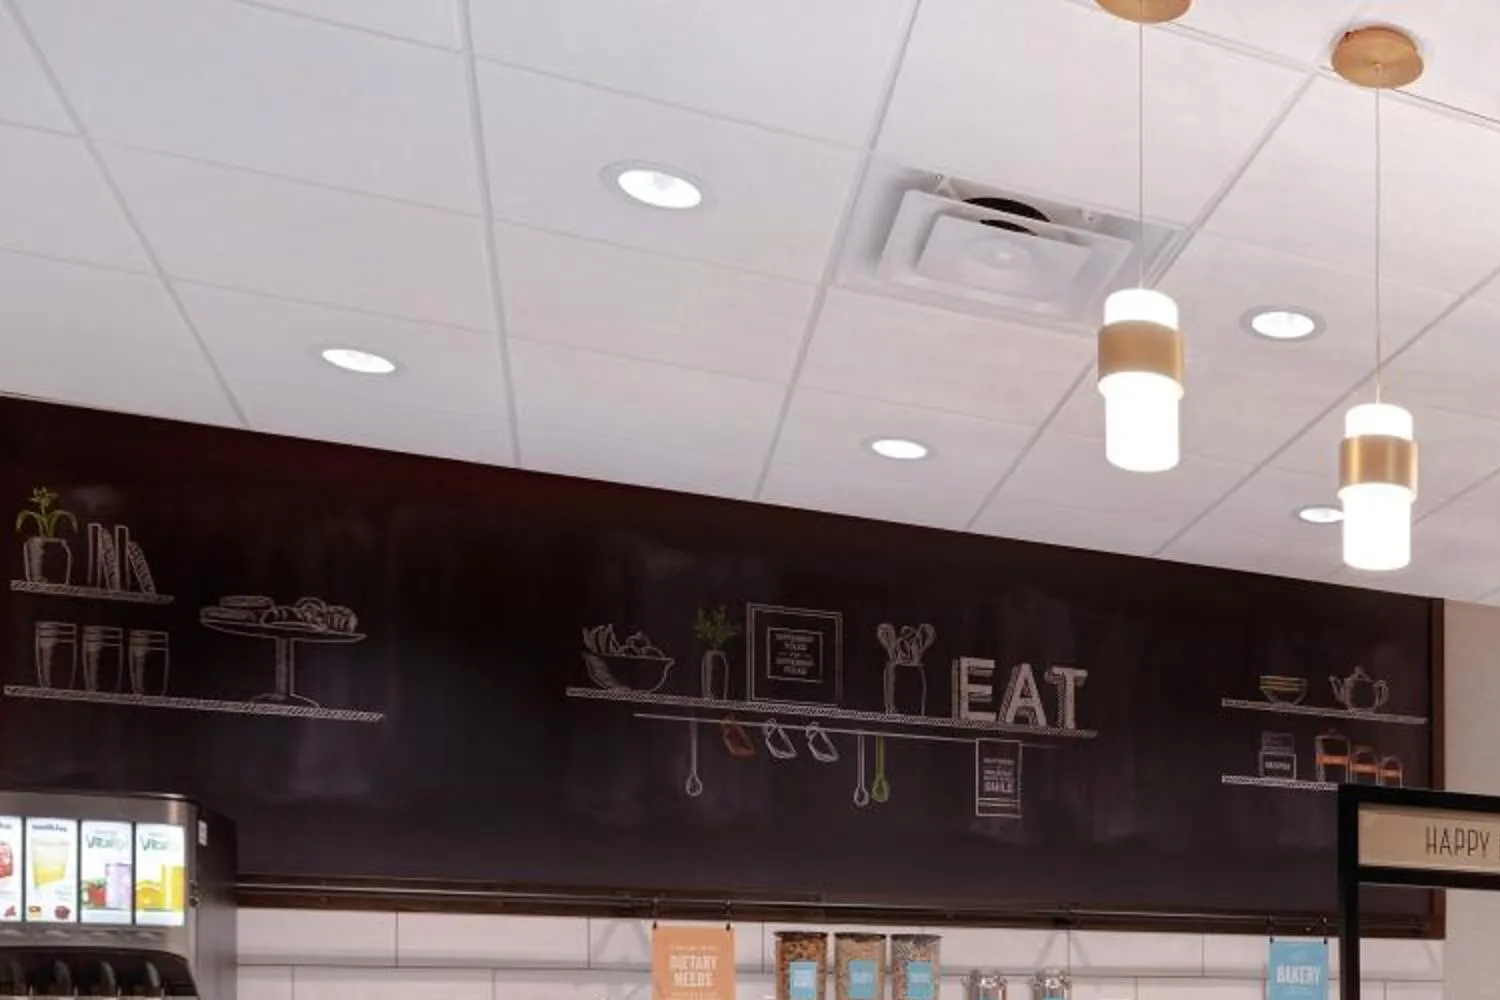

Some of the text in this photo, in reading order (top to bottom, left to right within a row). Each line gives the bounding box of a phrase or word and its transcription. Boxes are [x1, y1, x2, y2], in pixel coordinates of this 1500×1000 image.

[952, 656, 1088, 729] EAT
[1425, 826, 1490, 859] HAPPY
[669, 955, 718, 970] DIETARY
[673, 972, 713, 988] NEEDS
[1276, 965, 1321, 987] BAKERY
